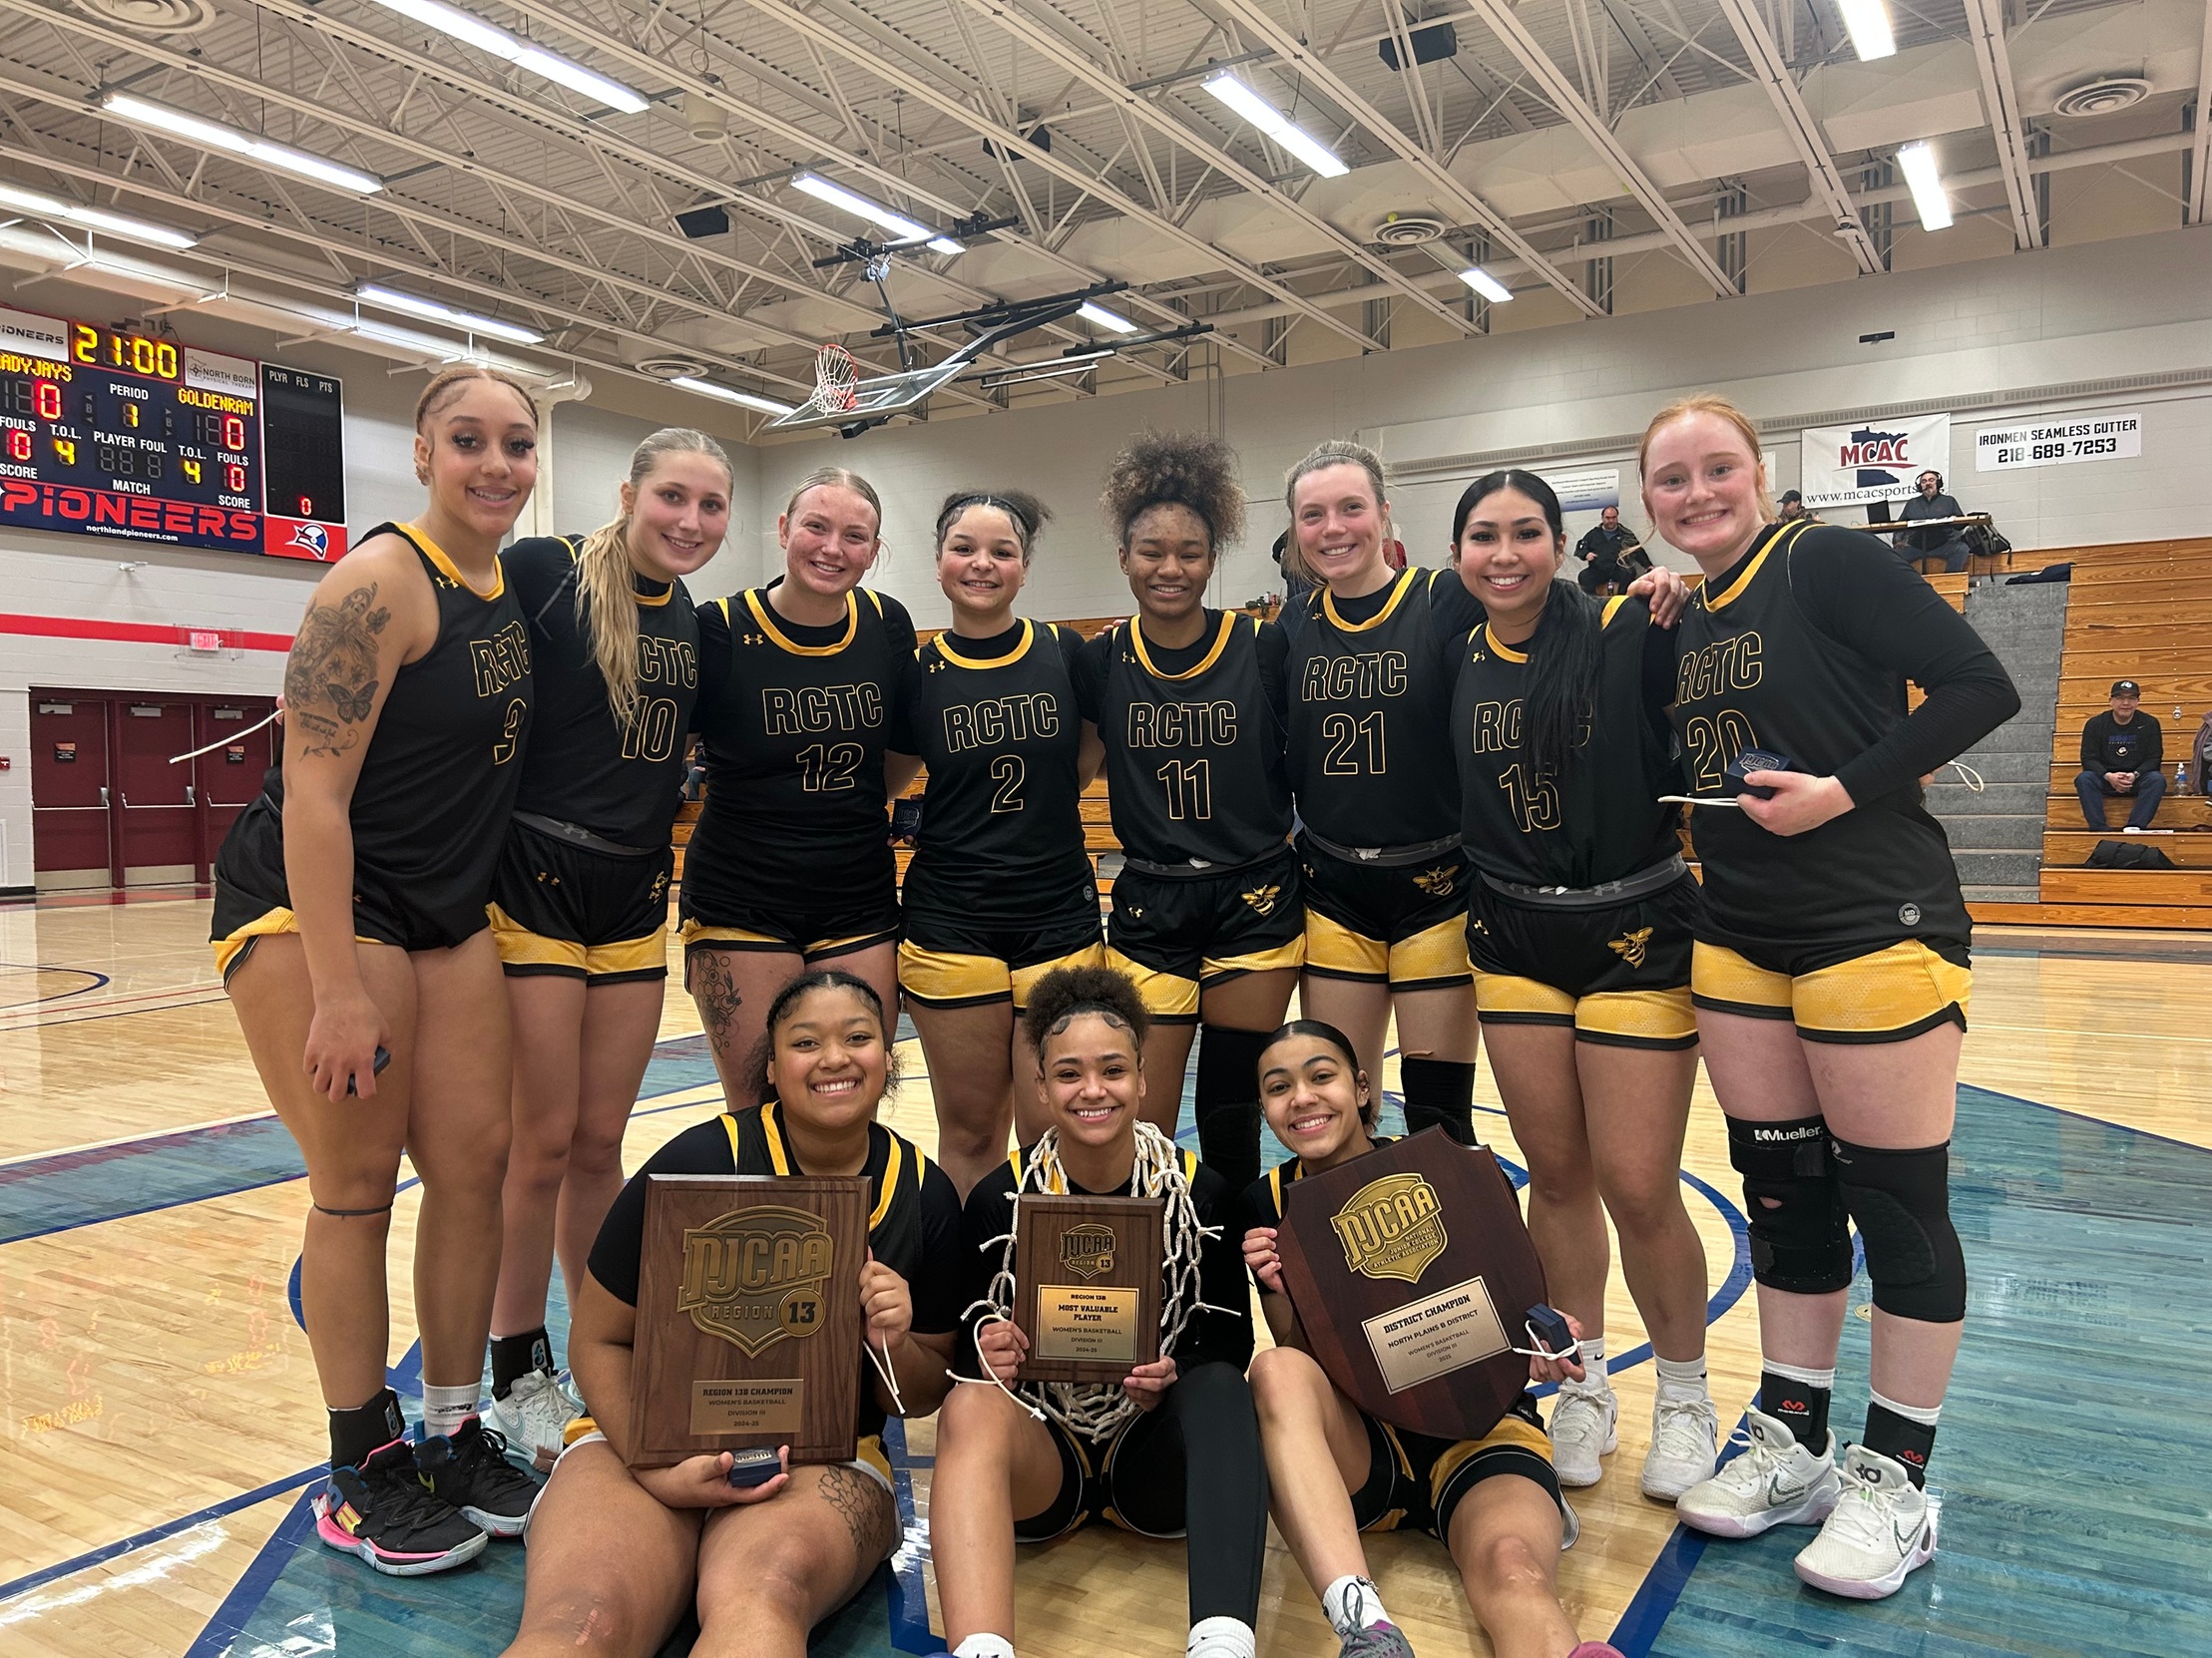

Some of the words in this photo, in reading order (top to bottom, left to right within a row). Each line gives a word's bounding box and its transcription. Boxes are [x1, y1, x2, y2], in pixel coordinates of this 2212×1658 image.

[76, 323, 178, 379] 21:00
[0, 353, 72, 383] ADYJAYS
[203, 367, 230, 380] NORTH
[232, 373, 255, 385] BORN
[269, 370, 288, 384] PLYR
[296, 376, 309, 388] FLS
[319, 381, 333, 393] PTS
[41, 384, 61, 420] 0
[110, 383, 149, 401] PERIOD
[178, 387, 253, 416] GOLDENRAM
[0, 417, 37, 433] FOULS
[50, 424, 82, 440] T.O.L.
[94, 430, 136, 448] PLAYER
[140, 439, 168, 453] FOUL
[226, 418, 244, 451] 0
[1979, 430, 2027, 447] IRONMEN
[2030, 423, 2090, 440] SEAMLESS
[2093, 419, 2137, 434] GUTTER
[15, 432, 32, 460] 0
[55, 439, 76, 466] 4
[178, 445, 207, 460] T.O.L.
[217, 452, 249, 467] FOULS
[1840, 439, 1909, 467] MCAC
[1997, 438, 2117, 464] 218-689-7253
[0, 463, 38, 479] SCORE
[184, 460, 202, 484] 4
[230, 467, 245, 492] 0
[113, 479, 151, 495] MATCH
[1806, 482, 1945, 503] www.mcacsports
[219, 495, 250, 509] SCORE
[300, 498, 312, 516] 0
[86, 525, 179, 542] northlandpioneers.com
[636, 634, 697, 689] CTC
[1301, 650, 1408, 701] RCTC
[1674, 630, 1763, 707] RCTC
[761, 681, 884, 735] RCTC
[622, 695, 677, 761] 10
[943, 692, 1060, 753] RCTC
[1127, 700, 1238, 748] RCTC
[1323, 710, 1387, 776] 21
[796, 742, 864, 792] 12
[990, 754, 1025, 814] 2
[1157, 759, 1211, 820] 11
[1498, 762, 1561, 833] 15
[1337, 1187, 1436, 1264] NJCAA
[1404, 1226, 1434, 1241] NATIONAL
[1063, 1236, 1112, 1260] NJCAA
[1373, 1254, 1402, 1268] ATHLETIC
[1402, 1240, 1439, 1258] ASSOCIATION
[1389, 1242, 1412, 1255] JUNIOR
[1411, 1232, 1437, 1246] COLLEGE
[686, 1237, 825, 1303] NJCAA
[1100, 1259, 1110, 1268] 13
[711, 1305, 773, 1320] REGION
[789, 1301, 817, 1324] 13
[1081, 1305, 1118, 1314] VALUABLE
[1383, 1312, 1423, 1334] DISTRICT
[1424, 1294, 1471, 1318] CHAMPION
[1387, 1334, 1413, 1349] NORTH
[1414, 1325, 1440, 1339] PLAINS
[1447, 1309, 1479, 1327] DISTRICT
[1407, 1343, 1435, 1356] WOMEN'S
[1435, 1330, 1470, 1346] BASKETBALL
[1426, 1345, 1451, 1358] DIVISION
